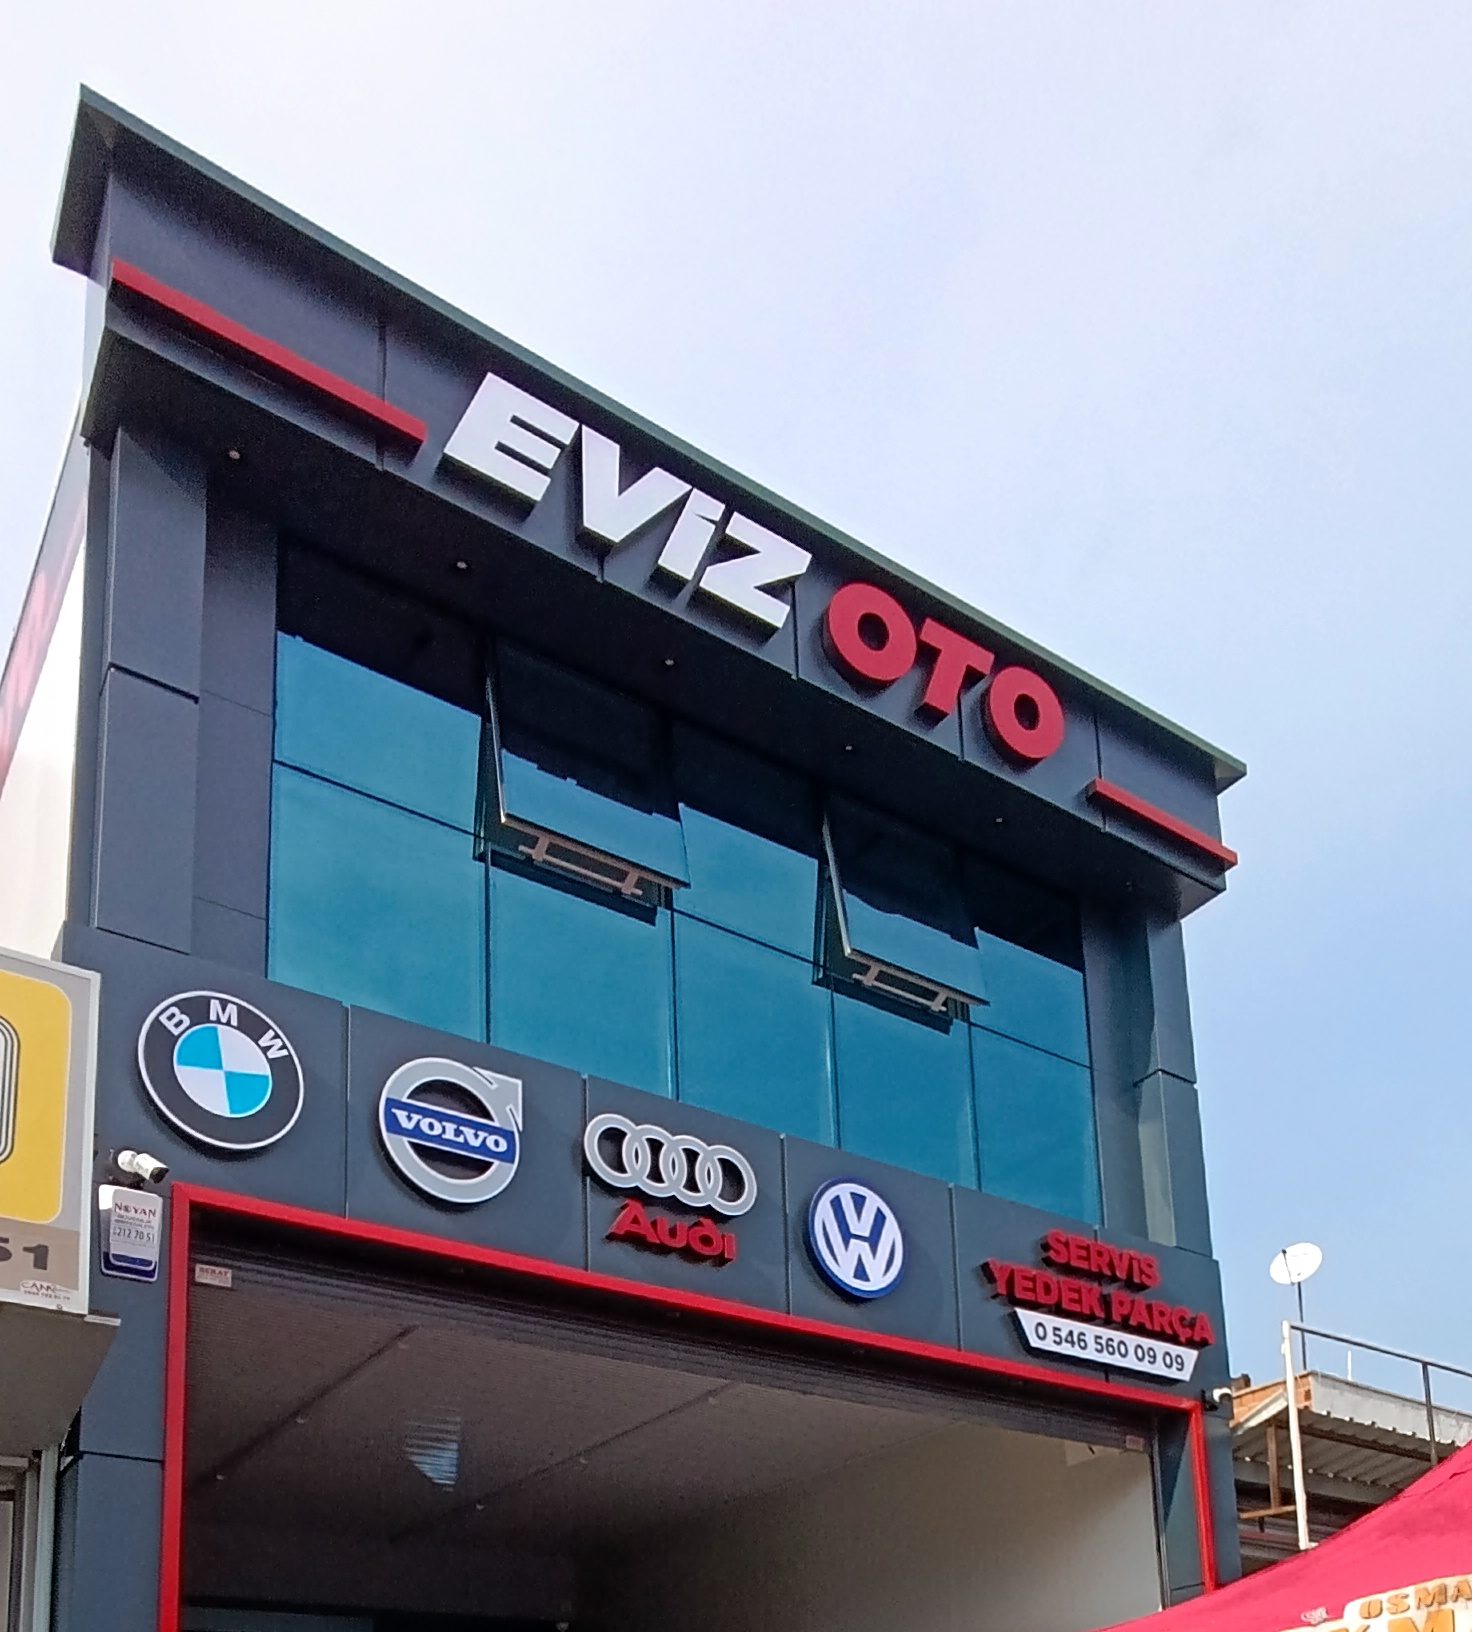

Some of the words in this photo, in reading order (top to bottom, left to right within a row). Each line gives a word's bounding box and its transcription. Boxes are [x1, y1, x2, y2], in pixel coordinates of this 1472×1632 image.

[826, 581, 1066, 760] OTO
[158, 999, 289, 1061] BMW
[390, 1108, 508, 1154] VOLVO
[609, 1200, 737, 1262] Audi
[986, 1257, 1106, 1319] YEDEK
[1109, 1289, 1217, 1346] PARÇA
[1052, 1326, 1088, 1351] 546
[1093, 1334, 1129, 1359] 560
[1133, 1343, 1158, 1366] 09
[1161, 1350, 1186, 1372] 09
